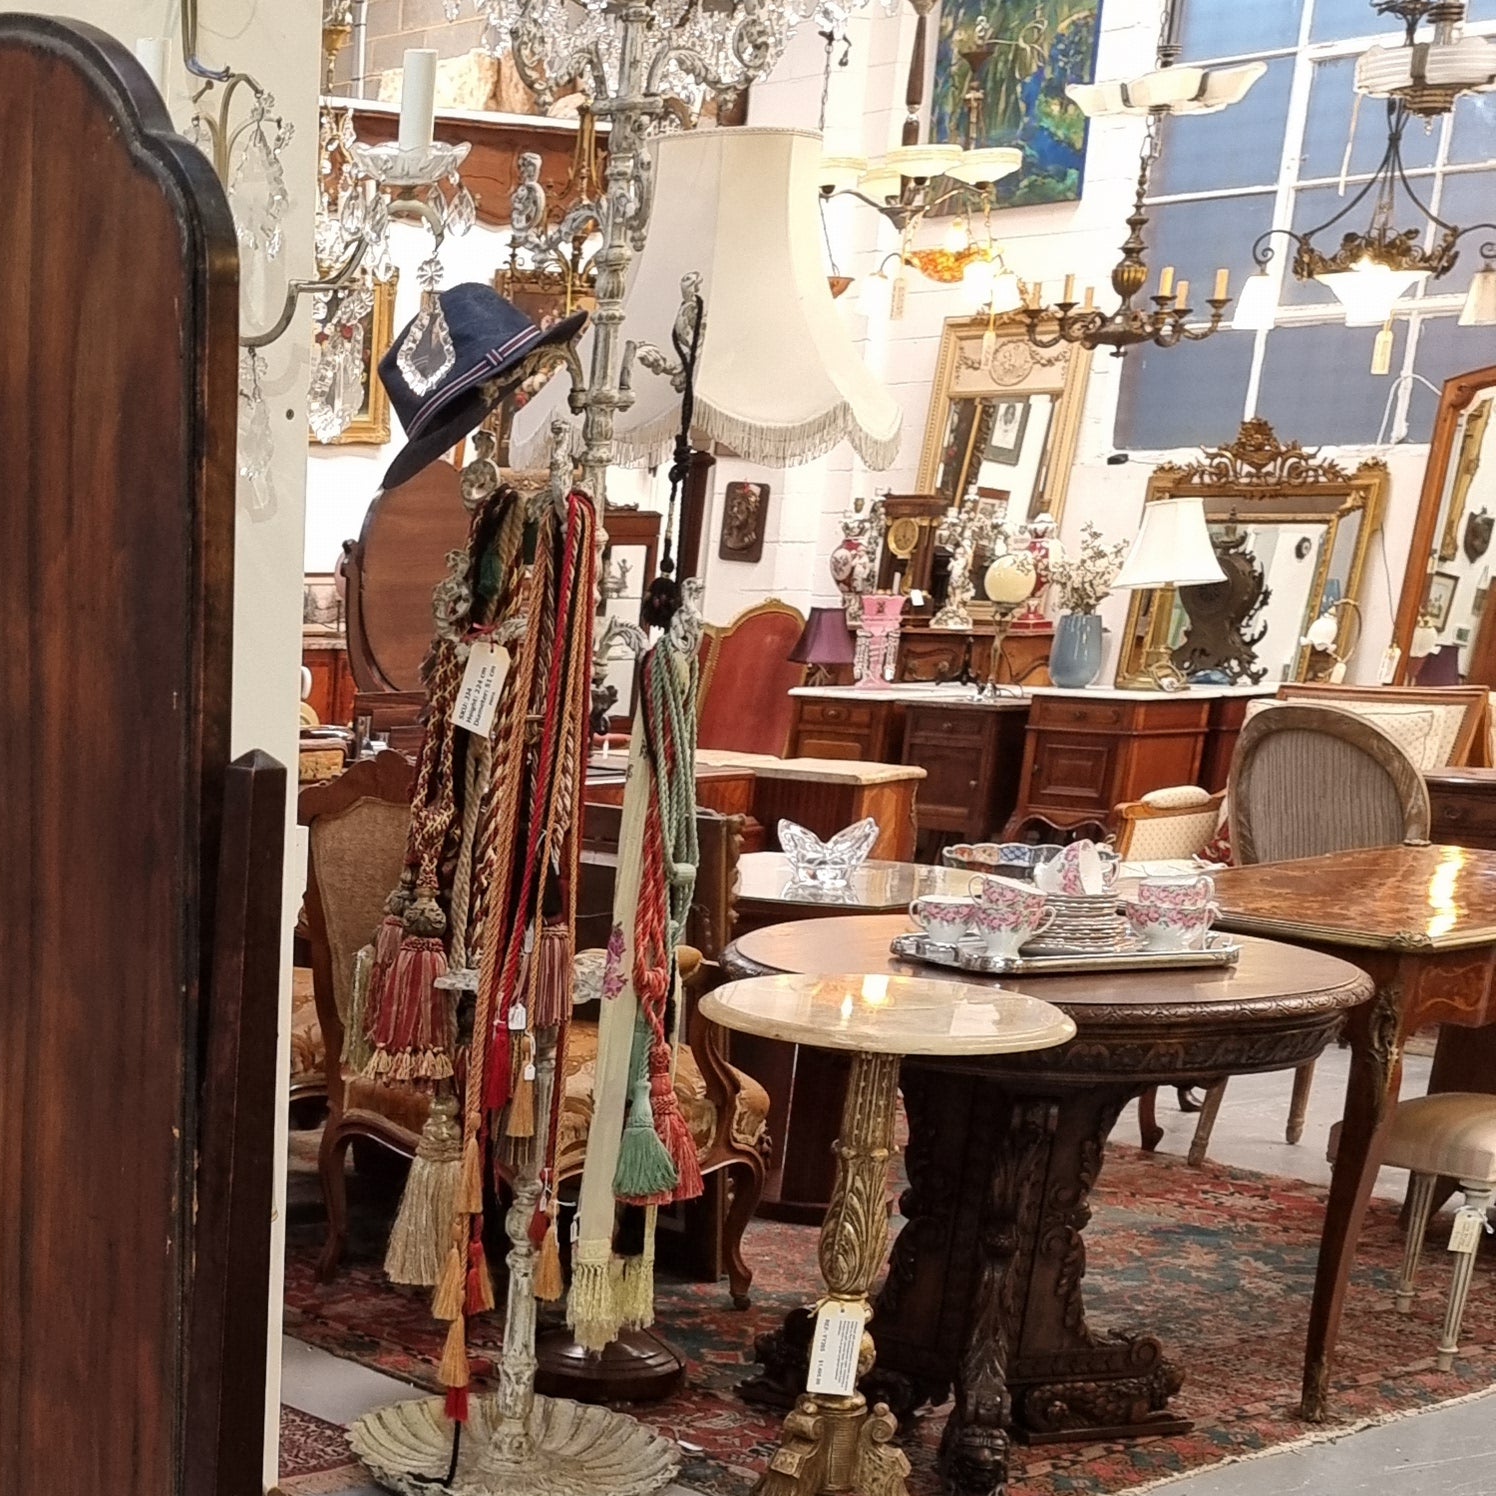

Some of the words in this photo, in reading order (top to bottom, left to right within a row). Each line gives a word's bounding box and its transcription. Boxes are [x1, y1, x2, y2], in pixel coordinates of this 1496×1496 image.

[466, 696, 478, 724] Height:
[474, 680, 483, 695] 224
[480, 666, 487, 679] cm
[473, 690, 489, 727] Diameter:
[489, 665, 496, 677] cm
